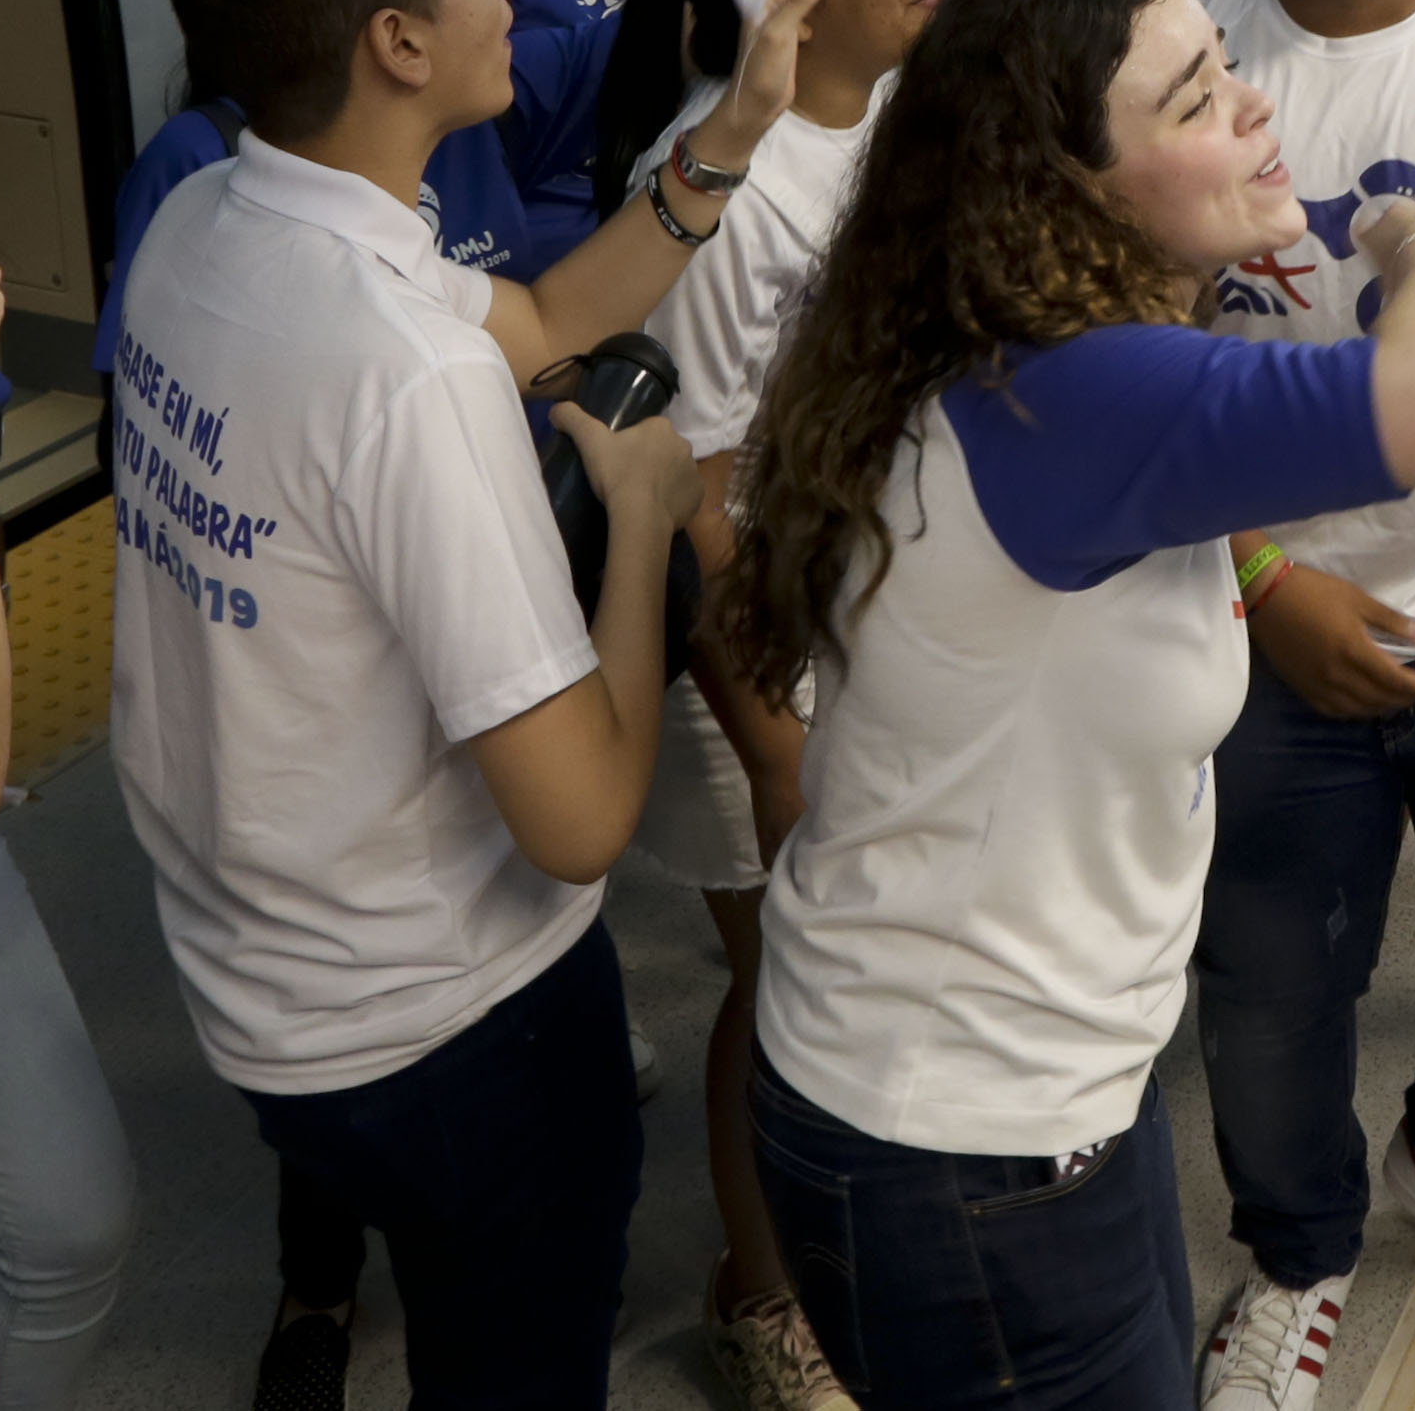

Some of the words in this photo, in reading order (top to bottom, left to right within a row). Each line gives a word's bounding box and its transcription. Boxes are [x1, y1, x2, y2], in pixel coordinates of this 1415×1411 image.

[448, 230, 494, 266] JMJ
[122, 418, 145, 476] TU
[162, 377, 193, 441] EN
[188, 406, 230, 476] MÍ,
